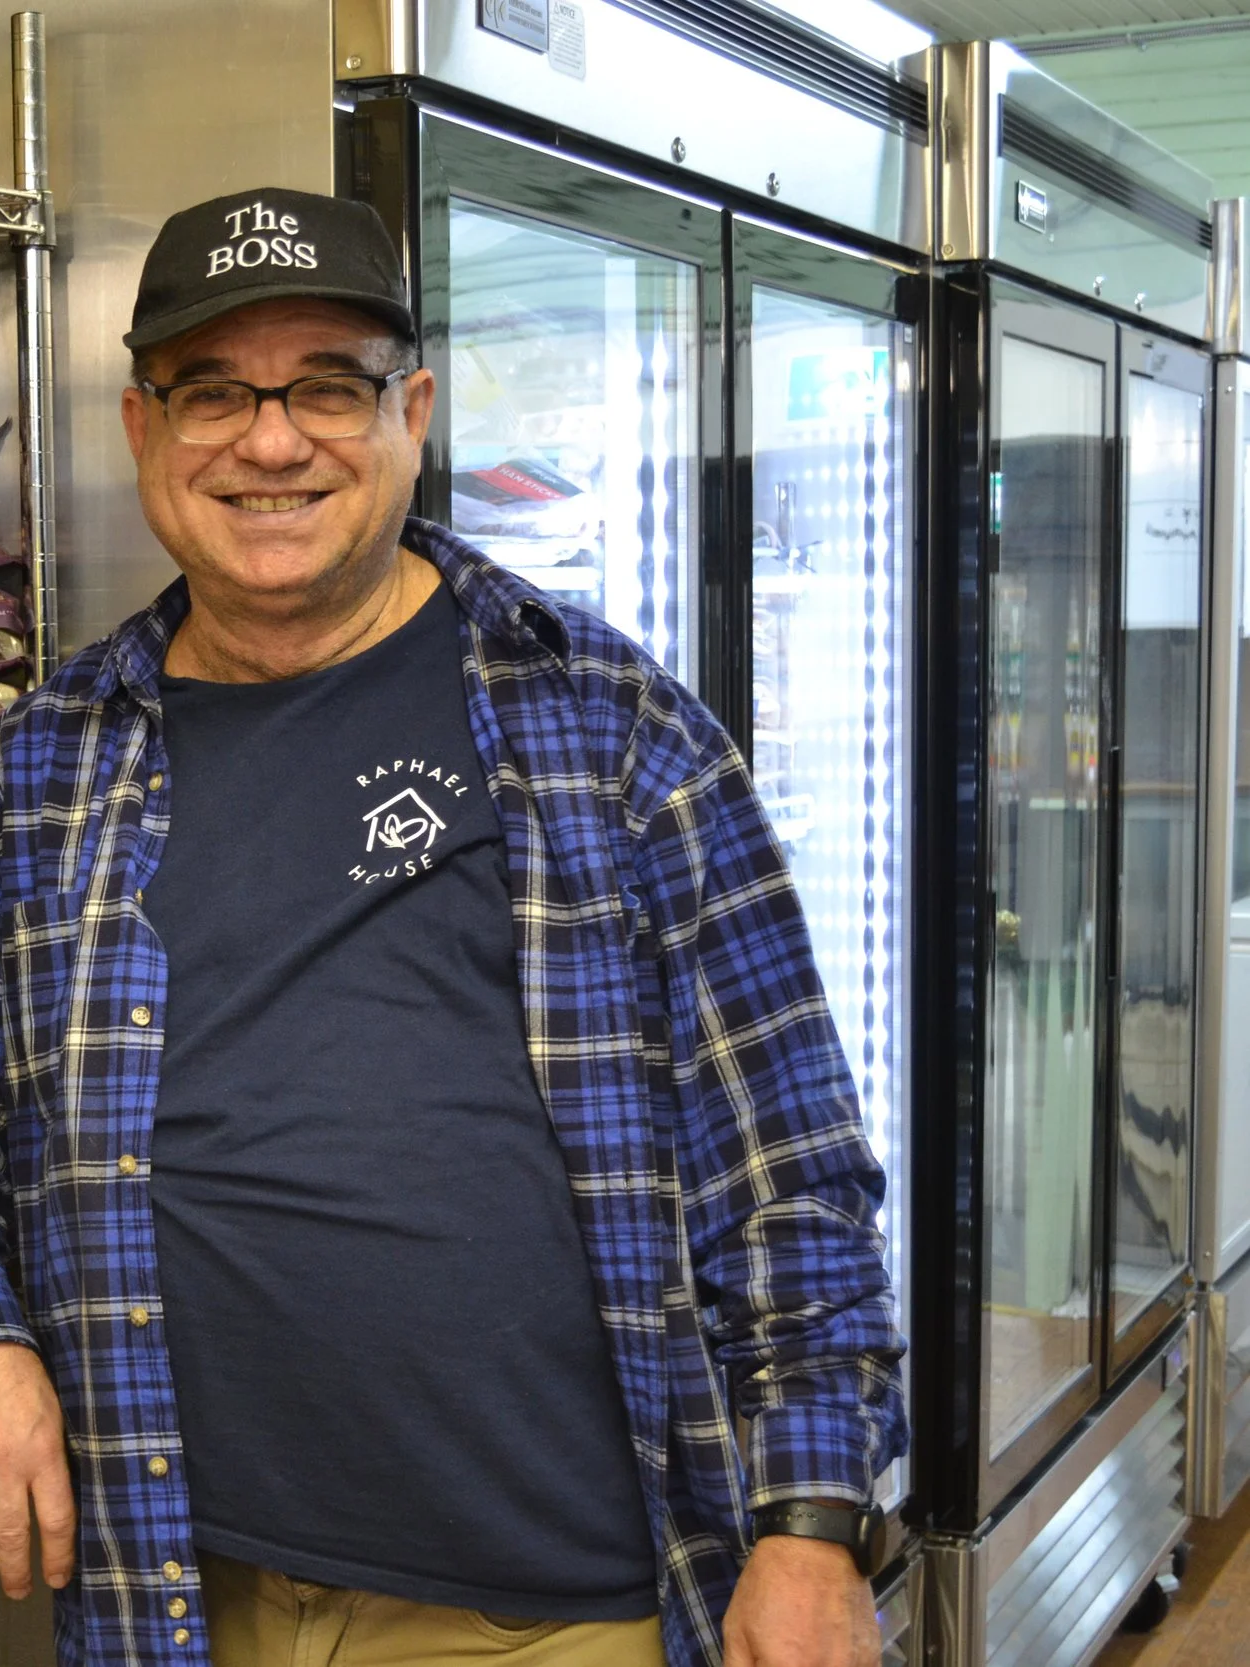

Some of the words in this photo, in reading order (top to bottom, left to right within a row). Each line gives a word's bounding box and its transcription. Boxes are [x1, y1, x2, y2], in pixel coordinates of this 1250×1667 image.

[224, 201, 299, 241] The
[205, 237, 319, 279] BOSS
[498, 467, 525, 483] HAM
[355, 758, 469, 798] RAPHAEL
[347, 852, 434, 885] HOUSE
